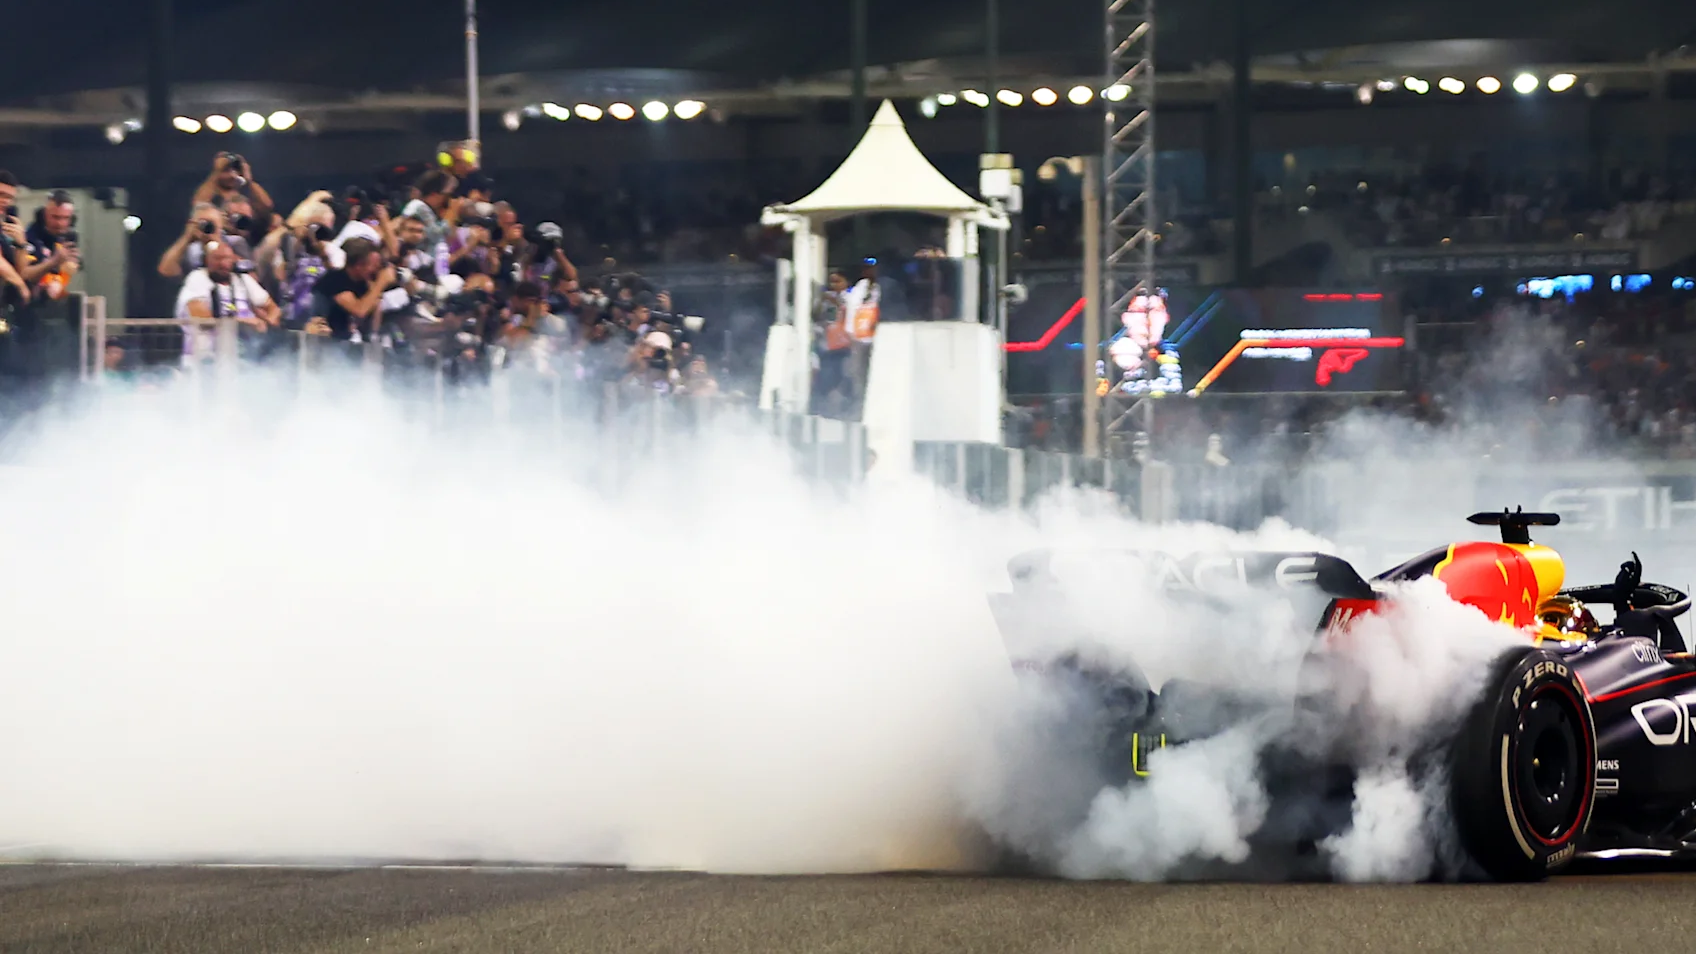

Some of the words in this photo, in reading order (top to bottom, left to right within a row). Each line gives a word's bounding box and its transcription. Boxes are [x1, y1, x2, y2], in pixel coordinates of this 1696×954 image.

[1146, 556, 1319, 591] ACLE
[1630, 640, 1664, 664] citrix
[1522, 660, 1568, 690] ZERO
[1596, 759, 1620, 770] MENS
